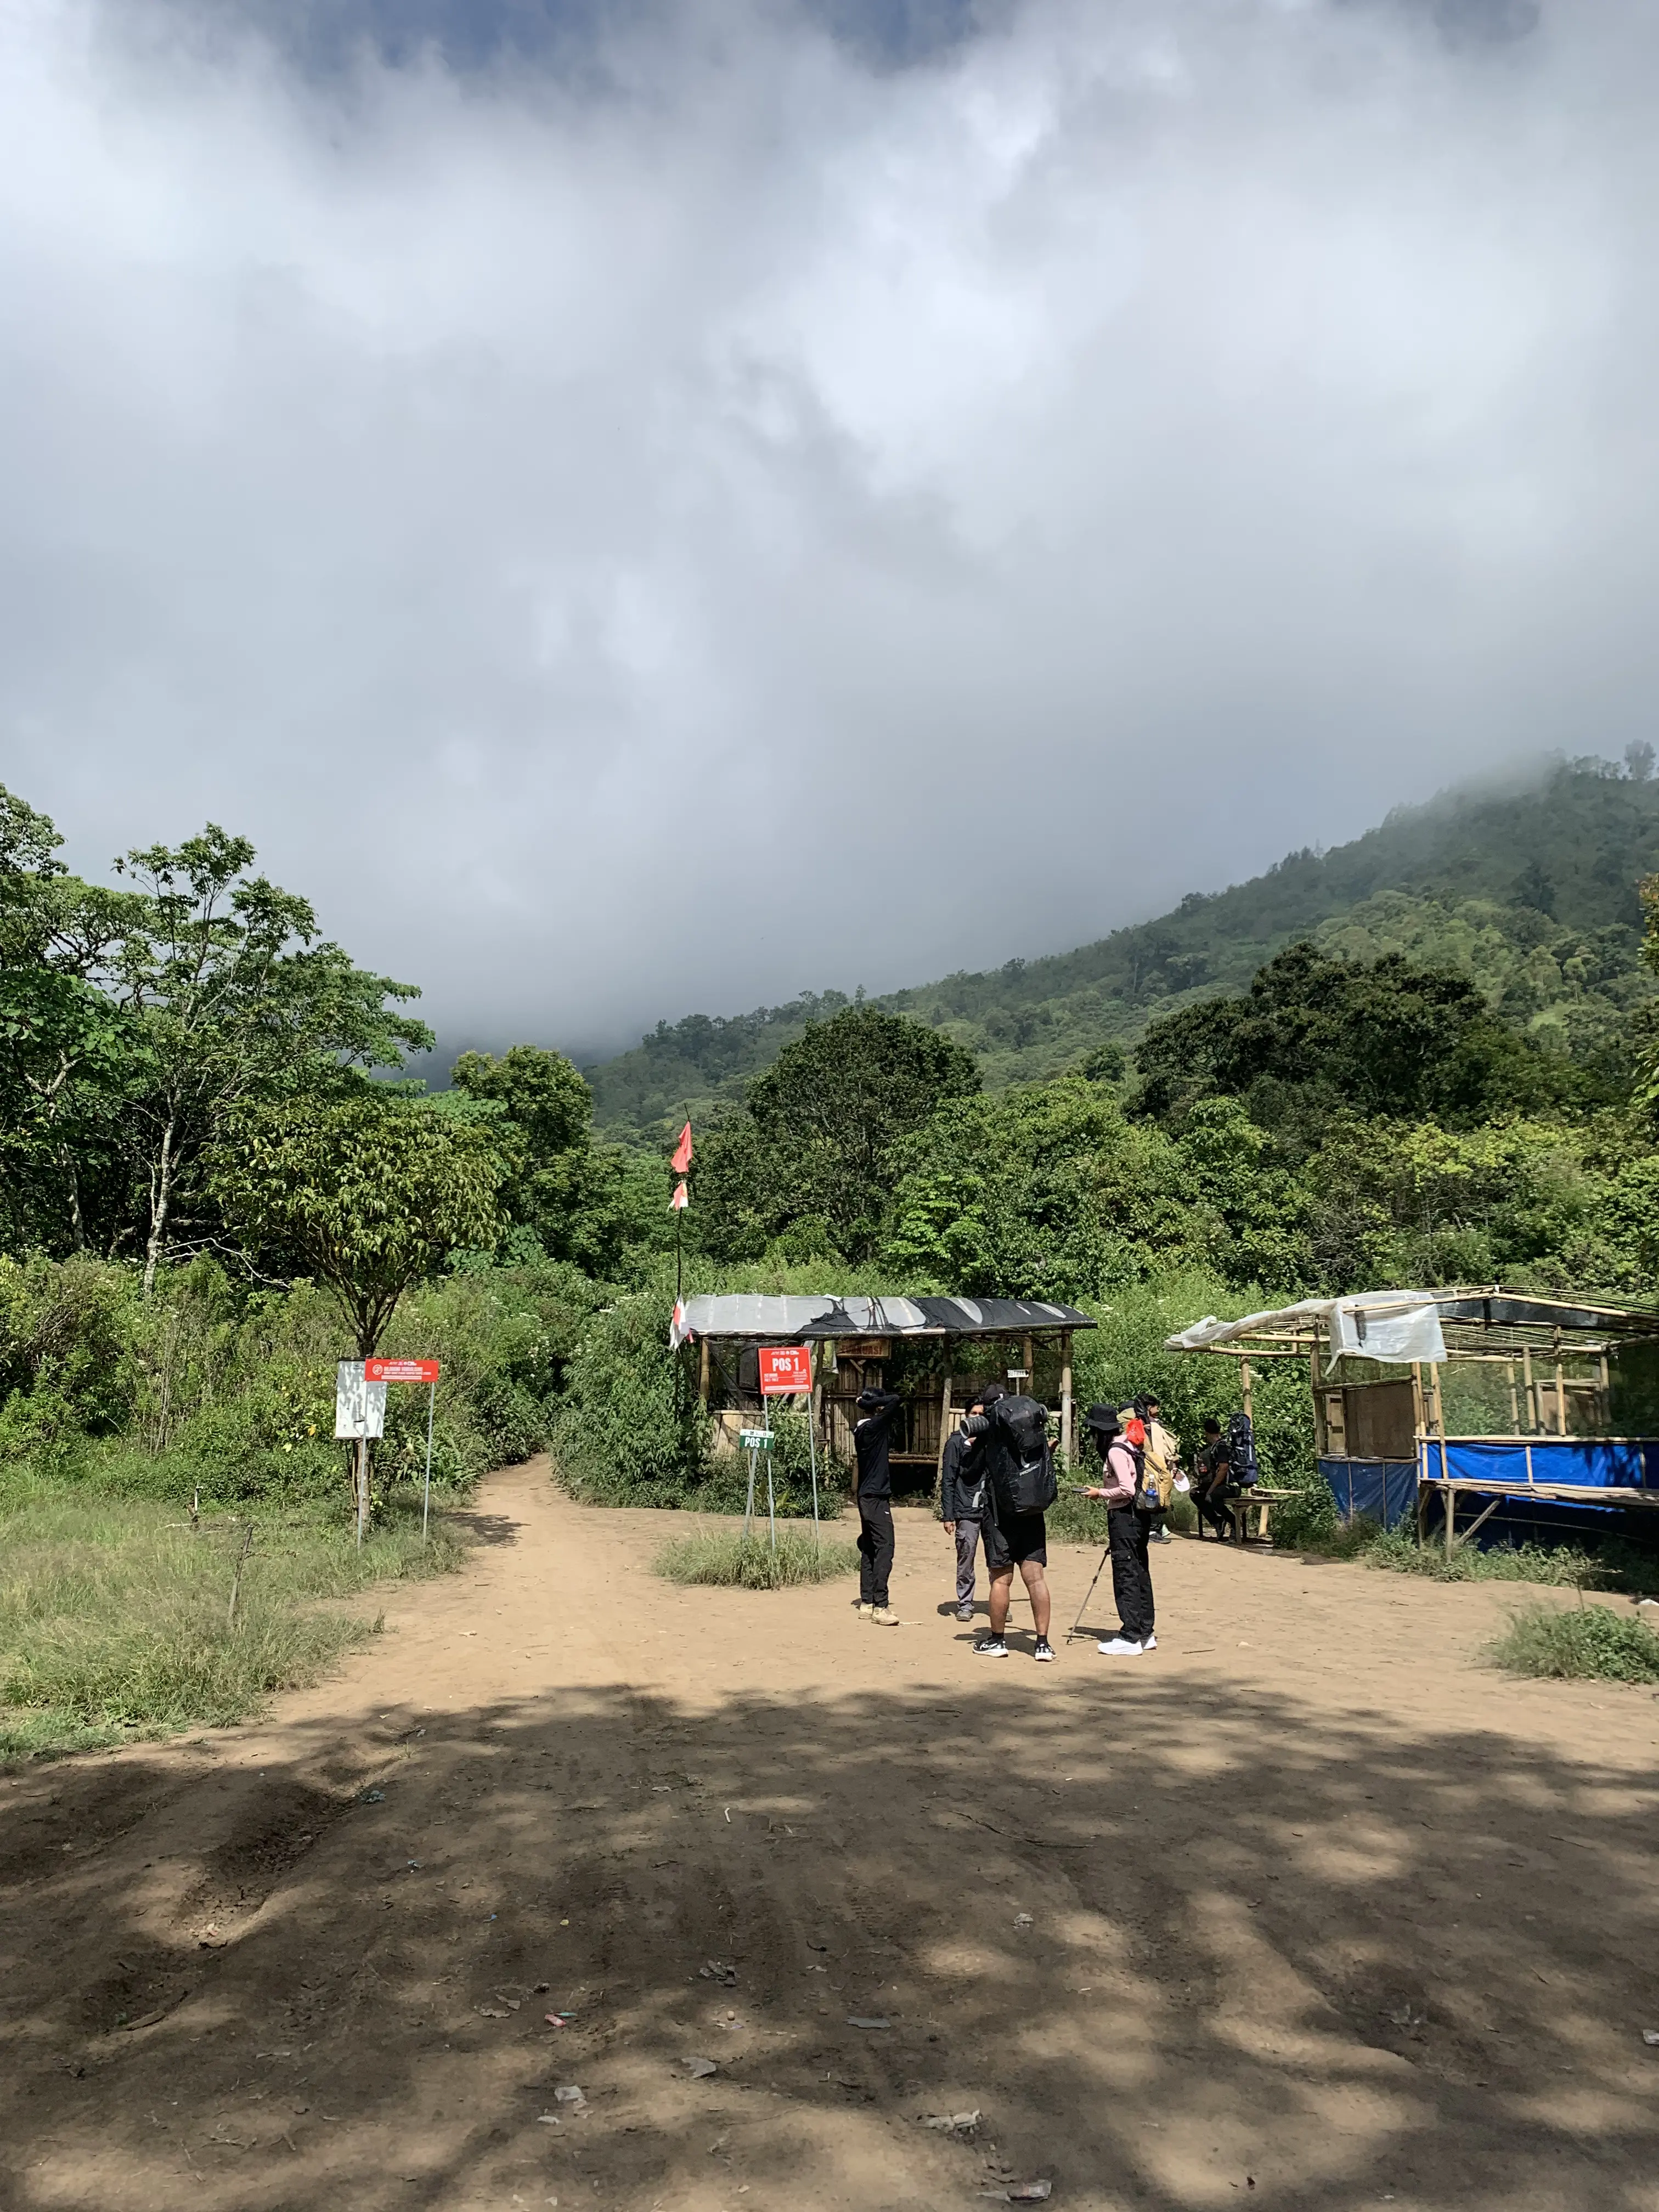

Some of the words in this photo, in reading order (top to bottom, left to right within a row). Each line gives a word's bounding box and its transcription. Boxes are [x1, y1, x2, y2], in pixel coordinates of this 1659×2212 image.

[772, 1357, 792, 1372] POS
[794, 1357, 799, 1372] 1
[744, 1436, 760, 1448] POS
[764, 1438, 768, 1448] 1
